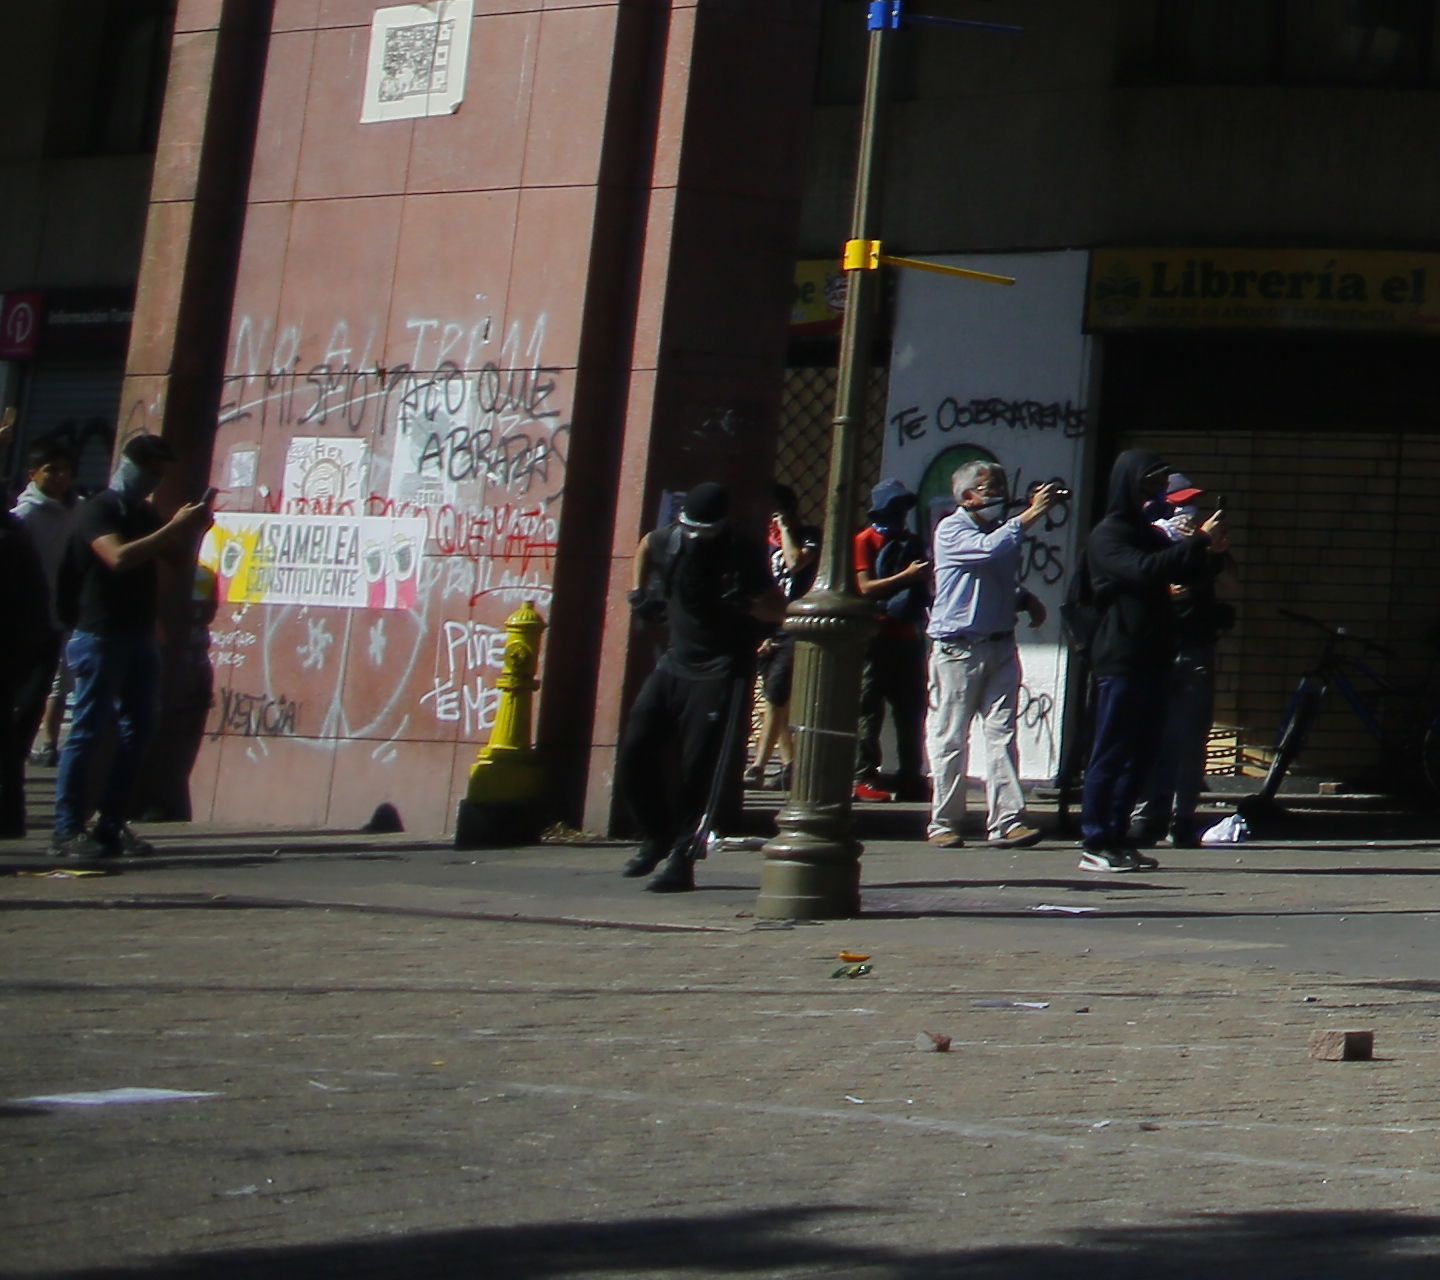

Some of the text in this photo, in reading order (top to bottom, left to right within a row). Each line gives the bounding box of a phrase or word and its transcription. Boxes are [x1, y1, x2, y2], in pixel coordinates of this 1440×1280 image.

[1148, 258, 1369, 303] Librería
[1379, 266, 1426, 304] el
[889, 406, 928, 447] TE
[252, 522, 361, 567] ASAMBLEA
[247, 566, 358, 598] CONSTITUYENTE
